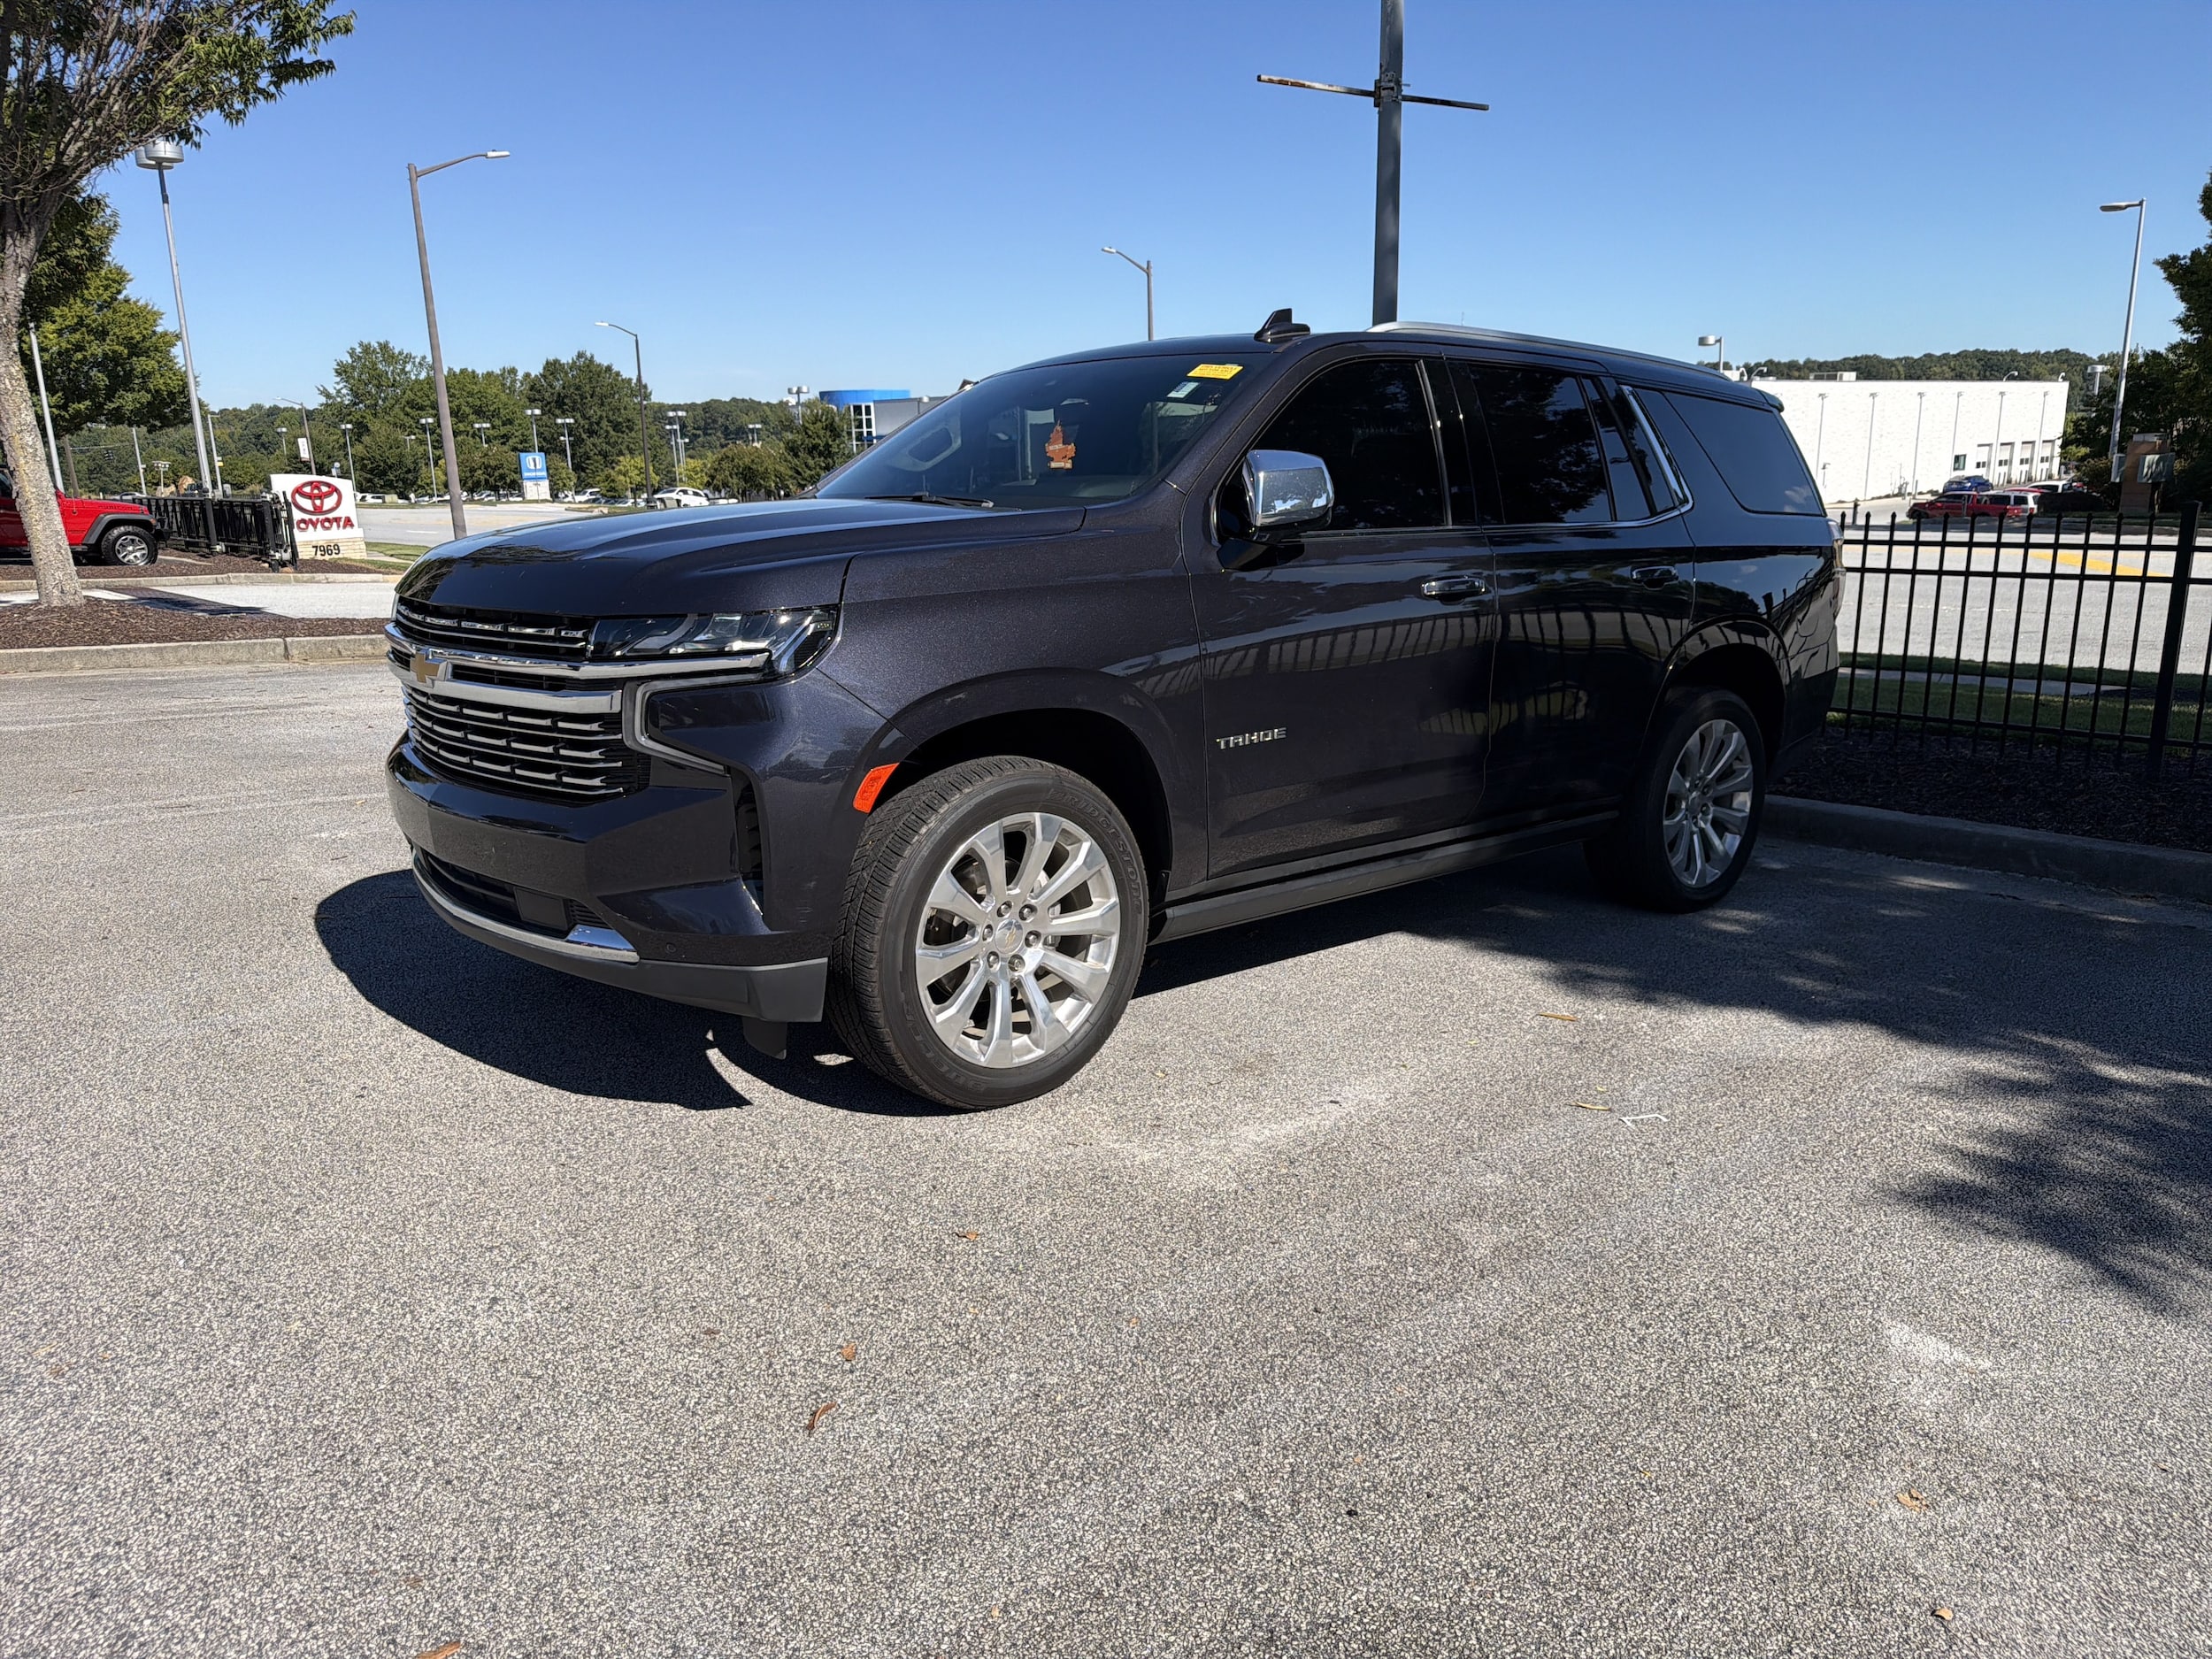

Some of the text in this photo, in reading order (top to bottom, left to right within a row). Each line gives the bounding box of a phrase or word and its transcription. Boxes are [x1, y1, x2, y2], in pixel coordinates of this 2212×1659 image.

[296, 516, 355, 532] OYOTA
[311, 543, 341, 557] 7969
[1216, 727, 1286, 749] TAHOE
[1048, 788, 1143, 915] BRIDGESTONE
